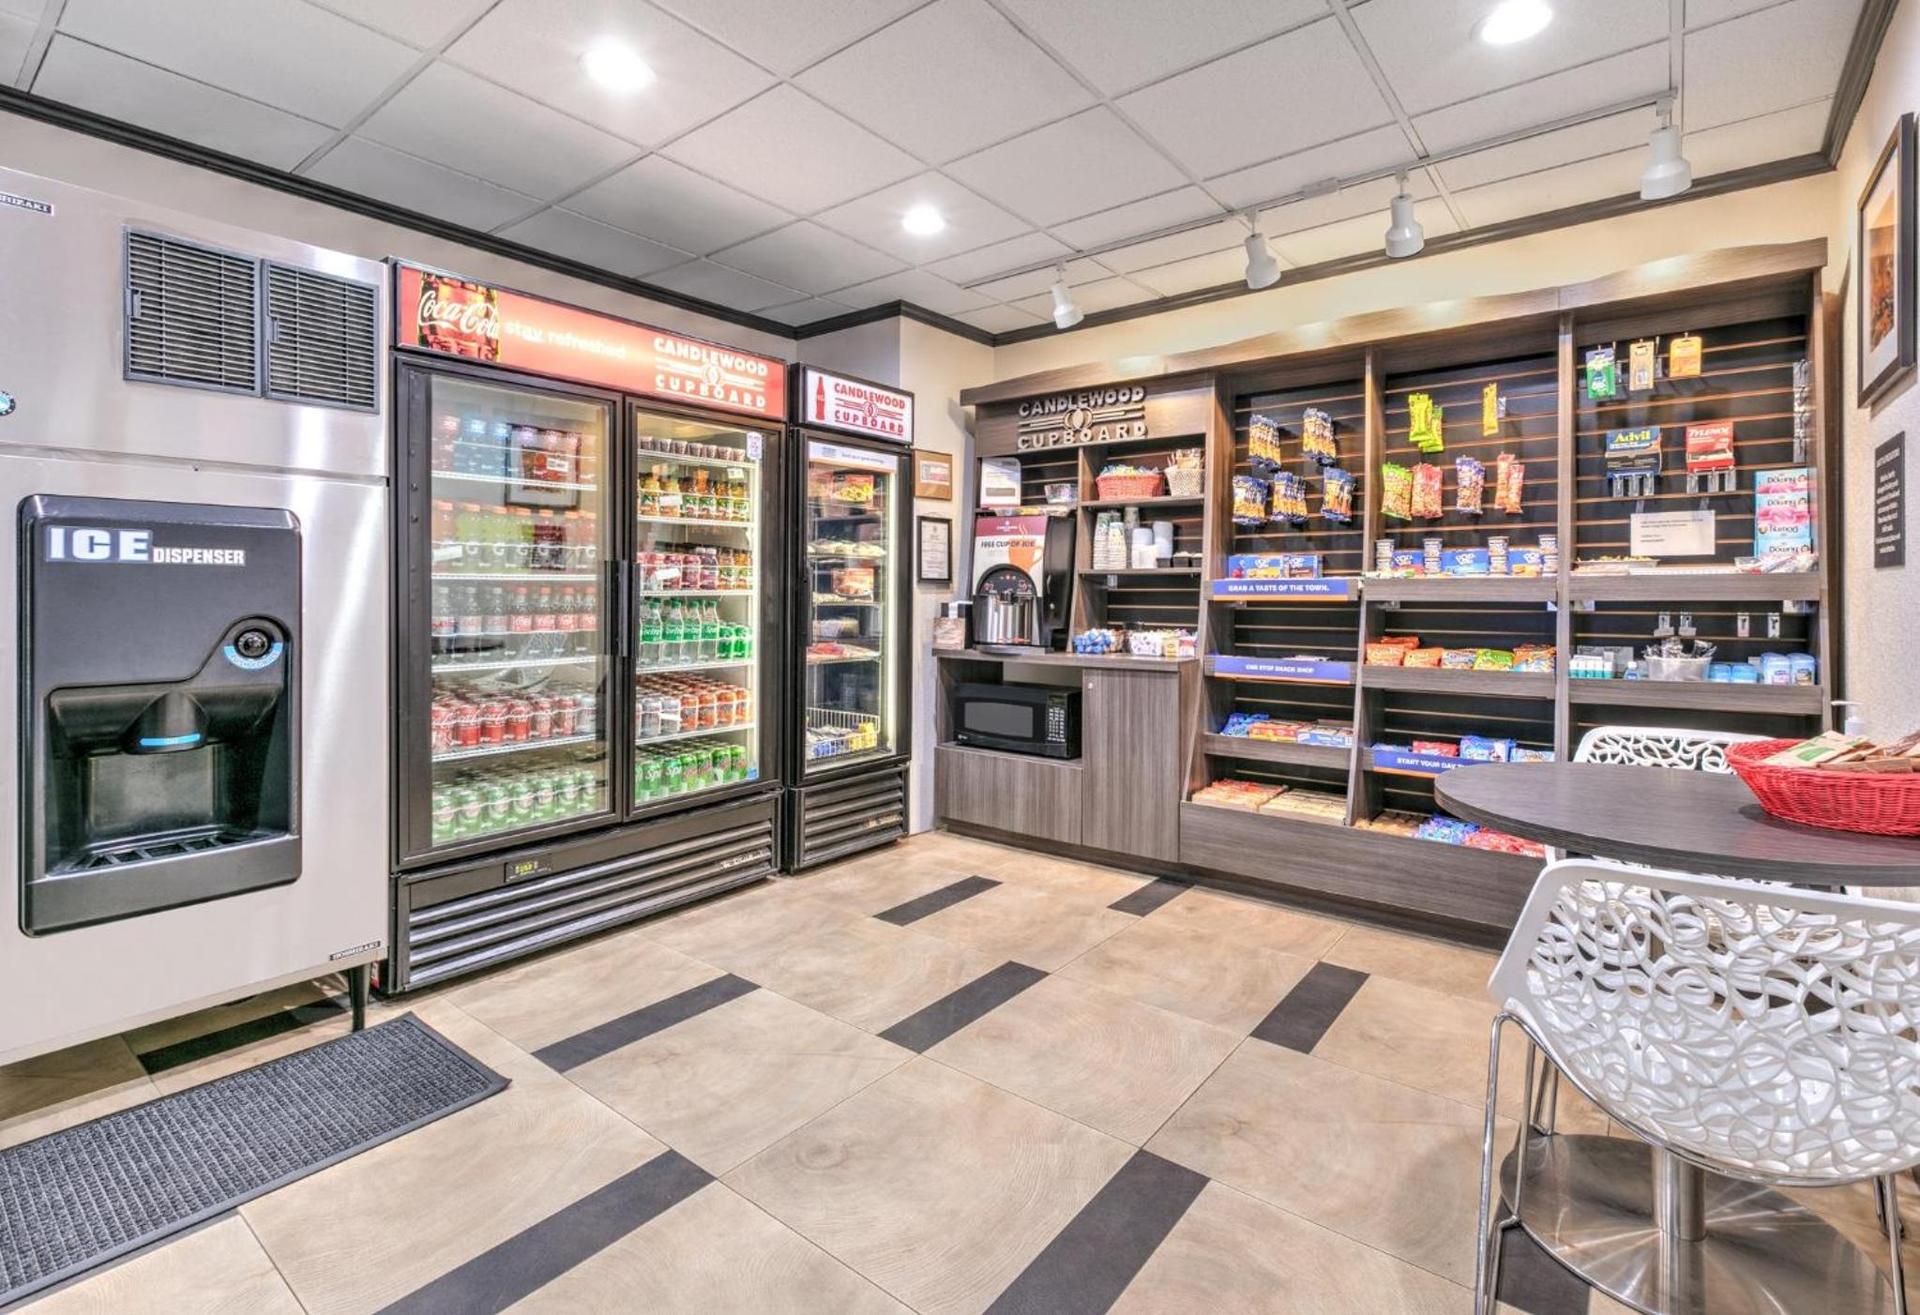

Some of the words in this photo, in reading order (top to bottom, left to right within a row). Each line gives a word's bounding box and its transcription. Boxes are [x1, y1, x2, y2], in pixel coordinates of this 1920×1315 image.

[653, 337, 768, 376] CANDLEWOOD
[655, 374, 766, 408] CUPBOARD
[834, 383, 905, 409] CANDLEWOOD
[1018, 386, 1145, 417] CANDLEWOOD
[834, 410, 904, 433] CUPBOARD
[1017, 421, 1147, 449] CUPBOARD
[1615, 430, 1651, 443] Advil
[50, 528, 150, 561] ICE
[153, 547, 245, 565] DISPENSER
[1278, 584, 1289, 592] OF
[1397, 757, 1419, 766] START
[1420, 759, 1441, 768] YOUR
